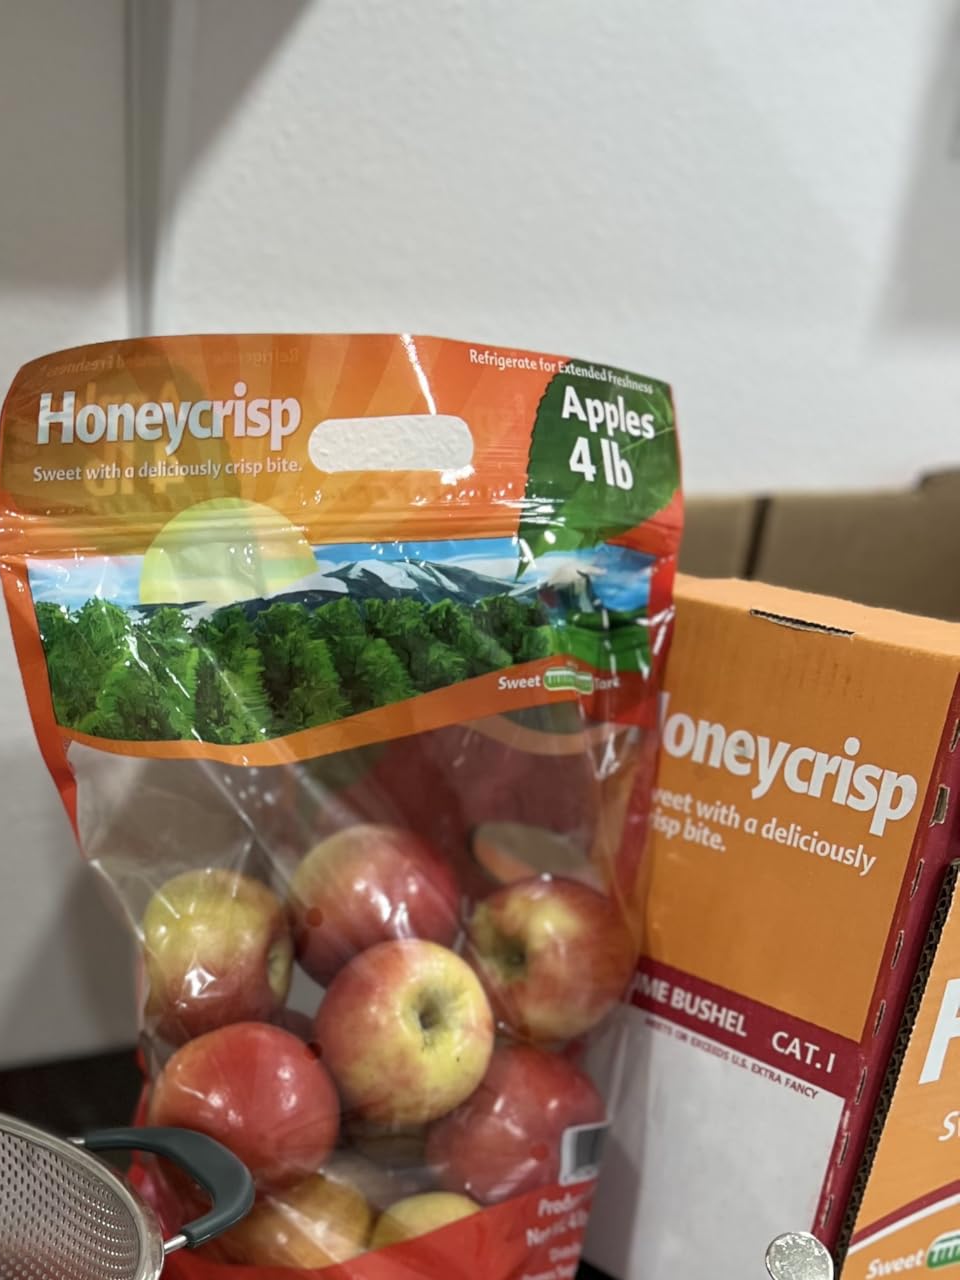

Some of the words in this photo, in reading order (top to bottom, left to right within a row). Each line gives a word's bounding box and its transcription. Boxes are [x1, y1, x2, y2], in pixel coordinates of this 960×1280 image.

[470, 349, 537, 370] Refrigerate
[539, 357, 556, 373] for
[558, 362, 607, 382] Extended
[608, 369, 653, 394] Freshness
[36, 381, 301, 455] Honeycrisp
[561, 385, 655, 440] Apples
[33, 466, 81, 482] Sweet
[86, 464, 121, 480] with
[124, 466, 135, 478] a
[138, 460, 222, 478] deliciously
[225, 457, 263, 476] crisp
[266, 457, 303, 473] bite.
[568, 436, 597, 482] 4
[599, 437, 634, 491] lb
[498, 675, 541, 690] Sweet
[683, 816, 727, 852] bite.
[696, 800, 740, 829] with
[743, 819, 757, 835] a
[761, 817, 877, 876] deliciously
[670, 985, 748, 1038] BUSHEL
[772, 1031, 822, 1070] CAT.
[751, 1062, 782, 1085] EXTRA
[784, 1077, 819, 1100] FANCY
[864, 1246, 926, 1280] Sweet
